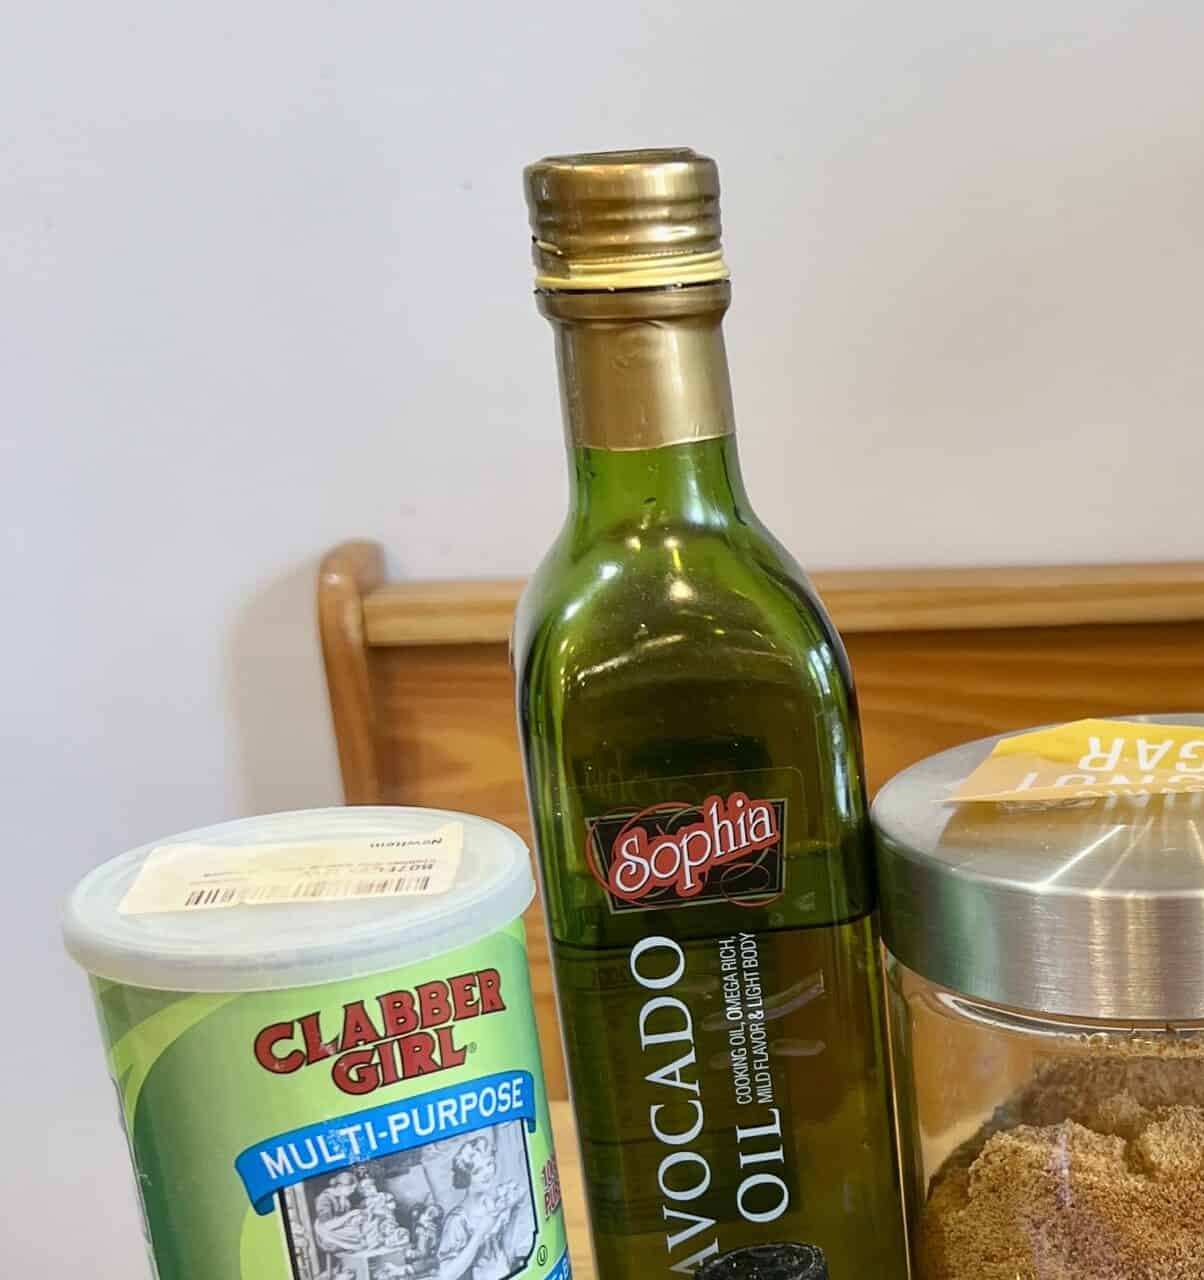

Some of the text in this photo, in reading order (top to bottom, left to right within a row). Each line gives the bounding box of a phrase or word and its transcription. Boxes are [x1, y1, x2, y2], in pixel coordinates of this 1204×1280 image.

[614, 799, 775, 894] Sophia
[253, 968, 507, 1075] CLABBER
[331, 1026, 467, 1096] GIRL
[719, 936, 752, 1105] COOKING OIL, OMEGA RICH,
[739, 932, 774, 1104] MILD FLAVOR & LIGHT BODY
[260, 1078, 524, 1180] MULTI-PURPOSE
[630, 936, 719, 1275] AVOCADO
[736, 1107, 789, 1223] OIL
